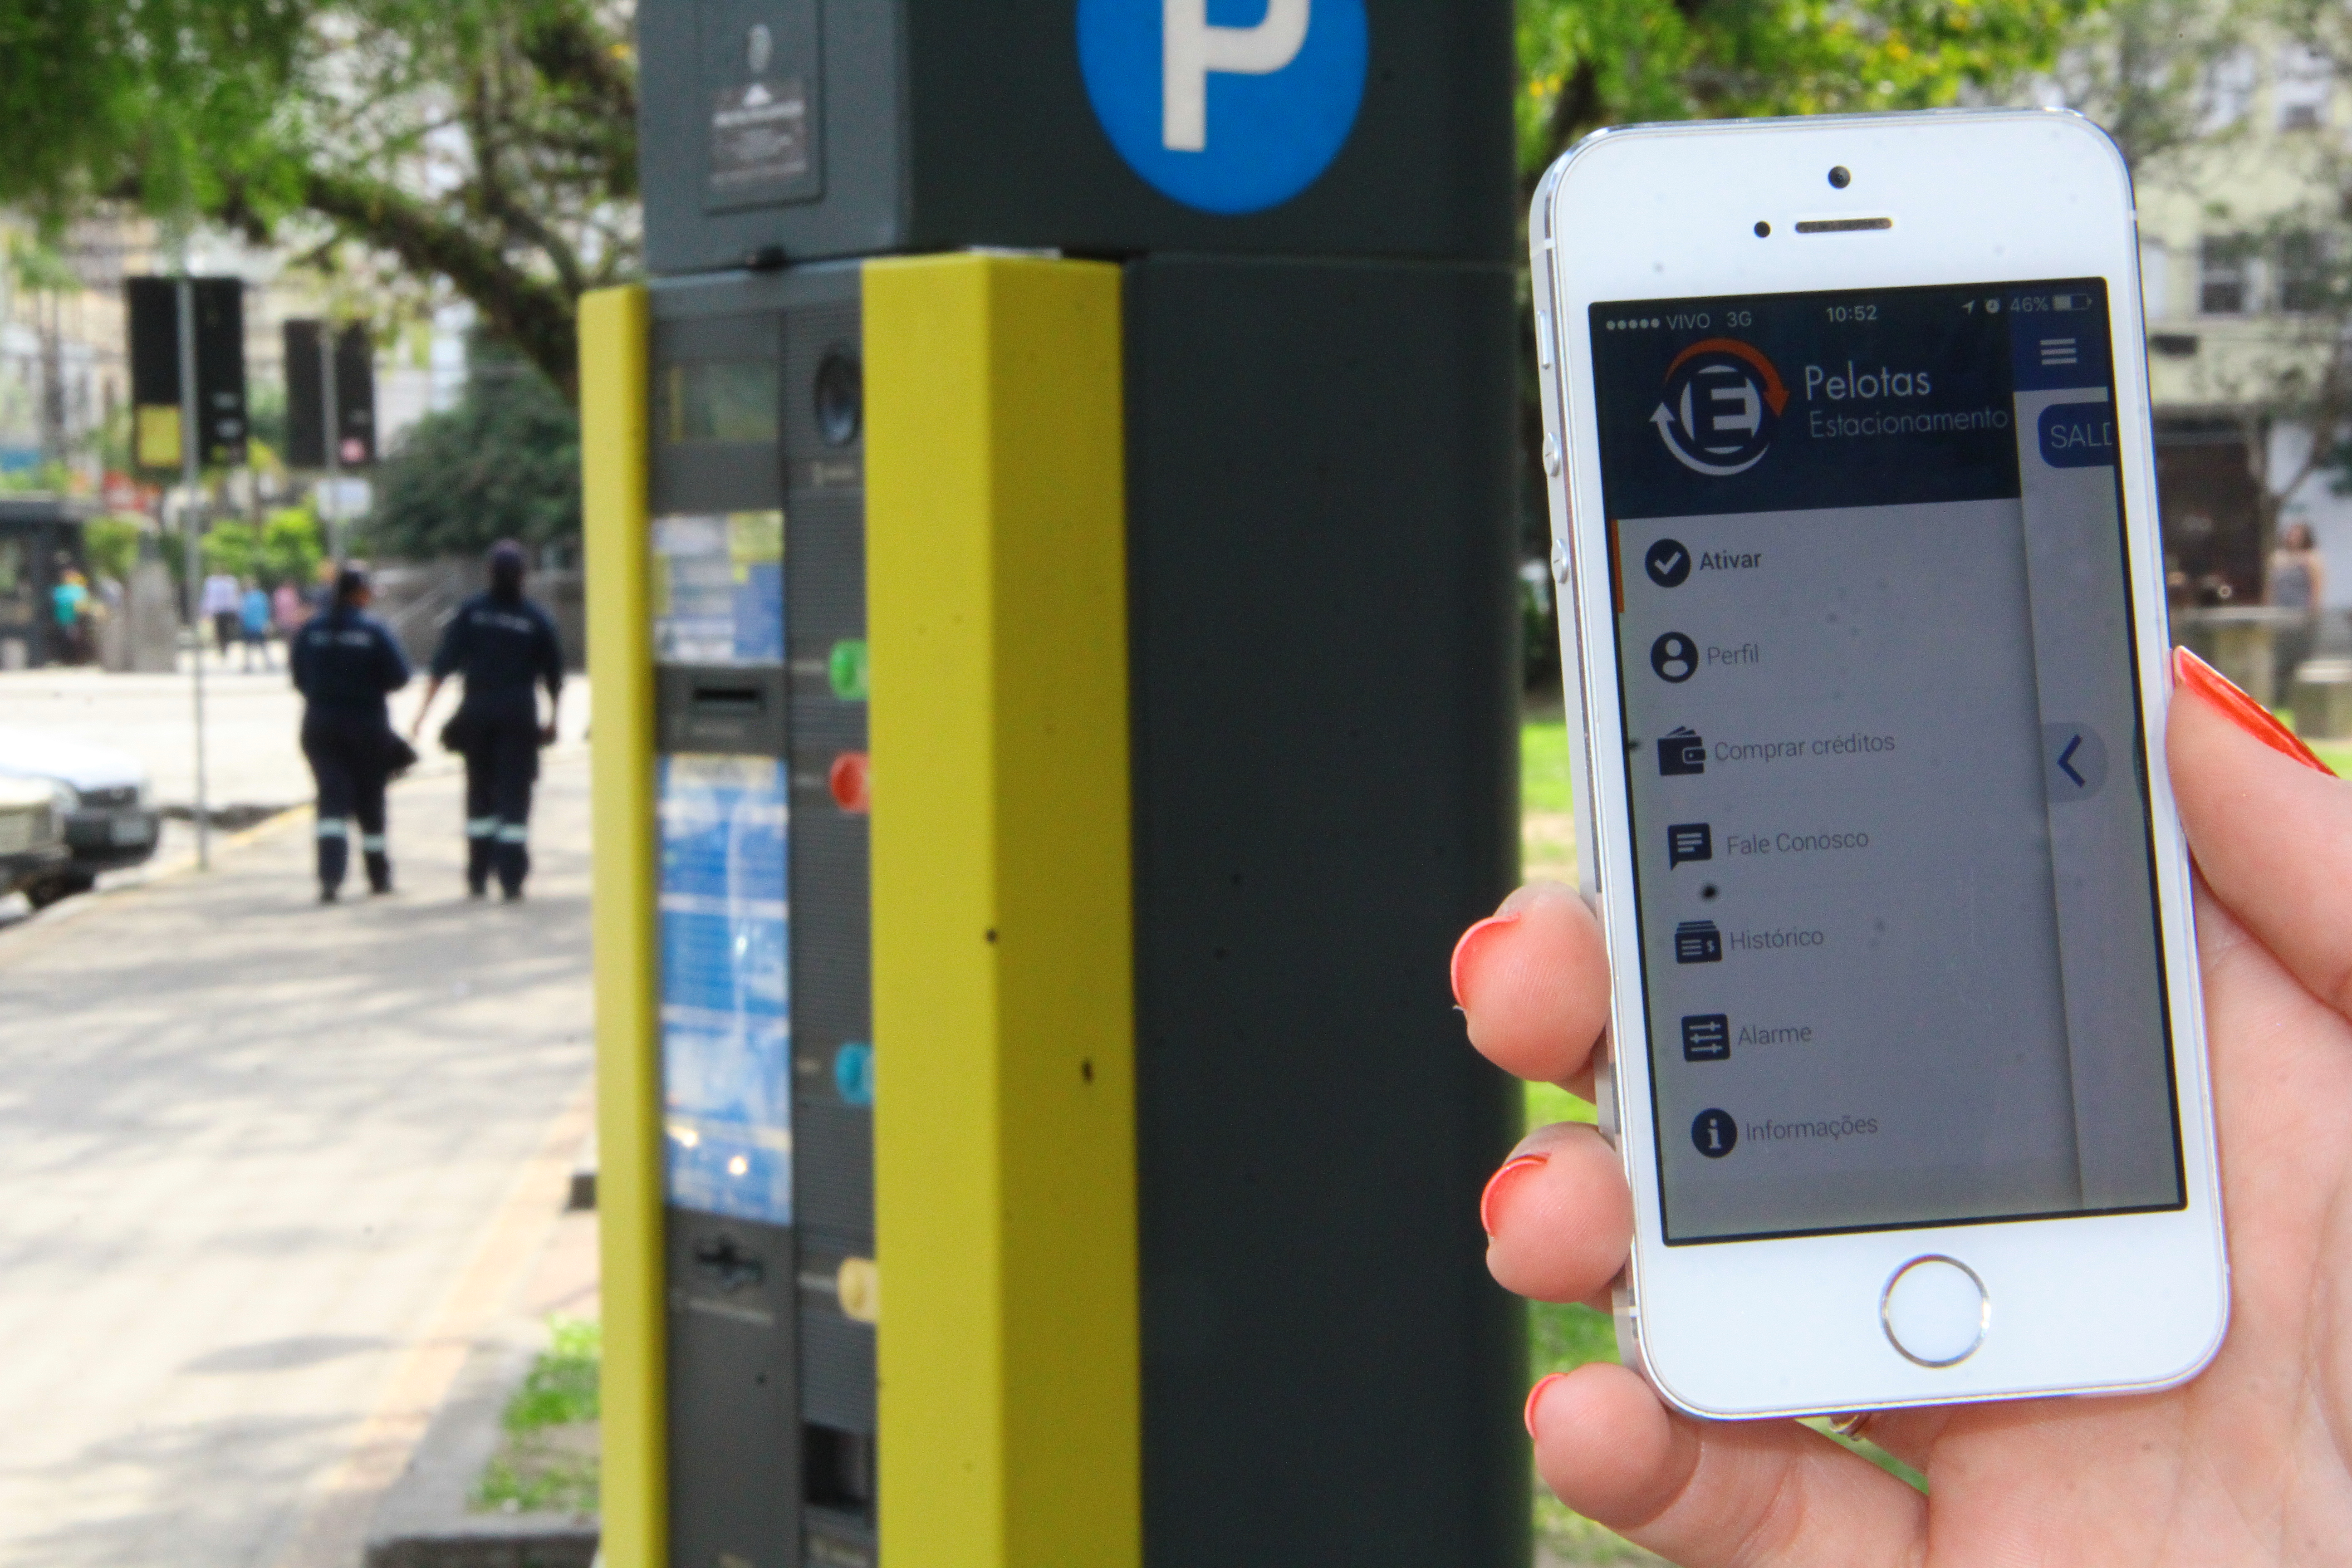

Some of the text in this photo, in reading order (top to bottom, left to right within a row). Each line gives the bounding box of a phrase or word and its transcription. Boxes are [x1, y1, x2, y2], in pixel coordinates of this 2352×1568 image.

[1162, 0, 1310, 152] P
[1827, 305, 1877, 323] 10:52
[2010, 296, 2049, 313] 46%
[1666, 312, 1752, 331] VIVO 3G
[1805, 360, 1931, 401] Pelotas
[1809, 408, 2009, 439] Estacionamento
[1700, 550, 1762, 570] Ativar
[1707, 643, 1759, 665] Perfil
[1715, 733, 1896, 762] Comprar créditos
[1728, 830, 1869, 854] Fale Conosco
[1730, 927, 1825, 951] Histórico
[1737, 1024, 1812, 1046] Alarme
[1745, 1114, 1879, 1141] Informações
